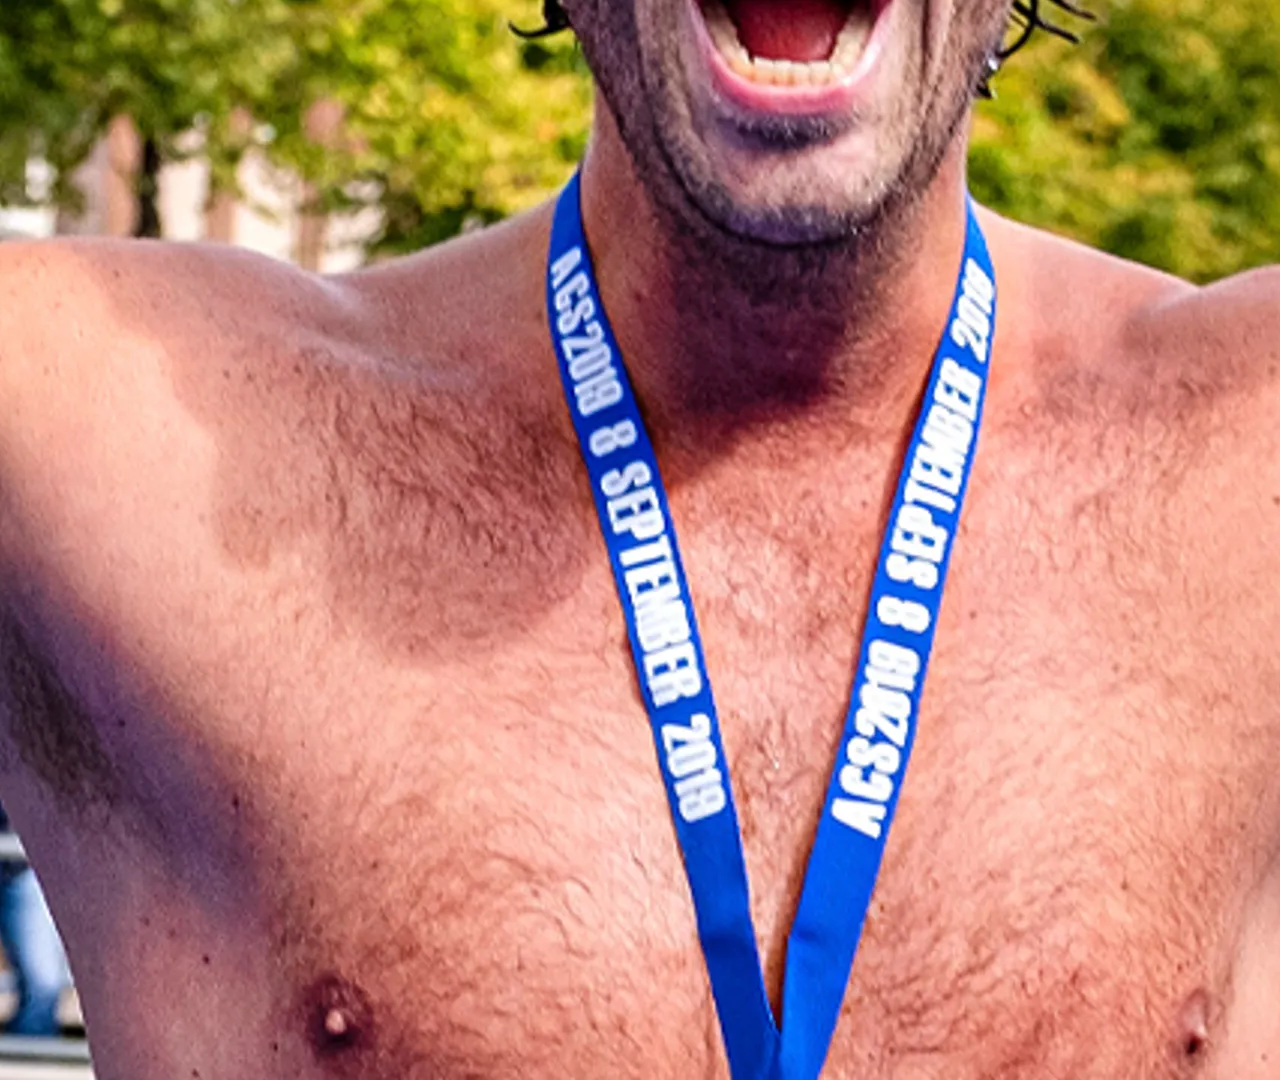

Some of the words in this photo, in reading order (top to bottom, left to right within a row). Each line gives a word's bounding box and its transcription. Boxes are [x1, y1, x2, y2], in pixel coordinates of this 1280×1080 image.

[589, 420, 637, 457] 8
[886, 358, 982, 589] SEPTEMBER
[601, 461, 701, 707] SEPTEMBER
[877, 594, 930, 635] 8
